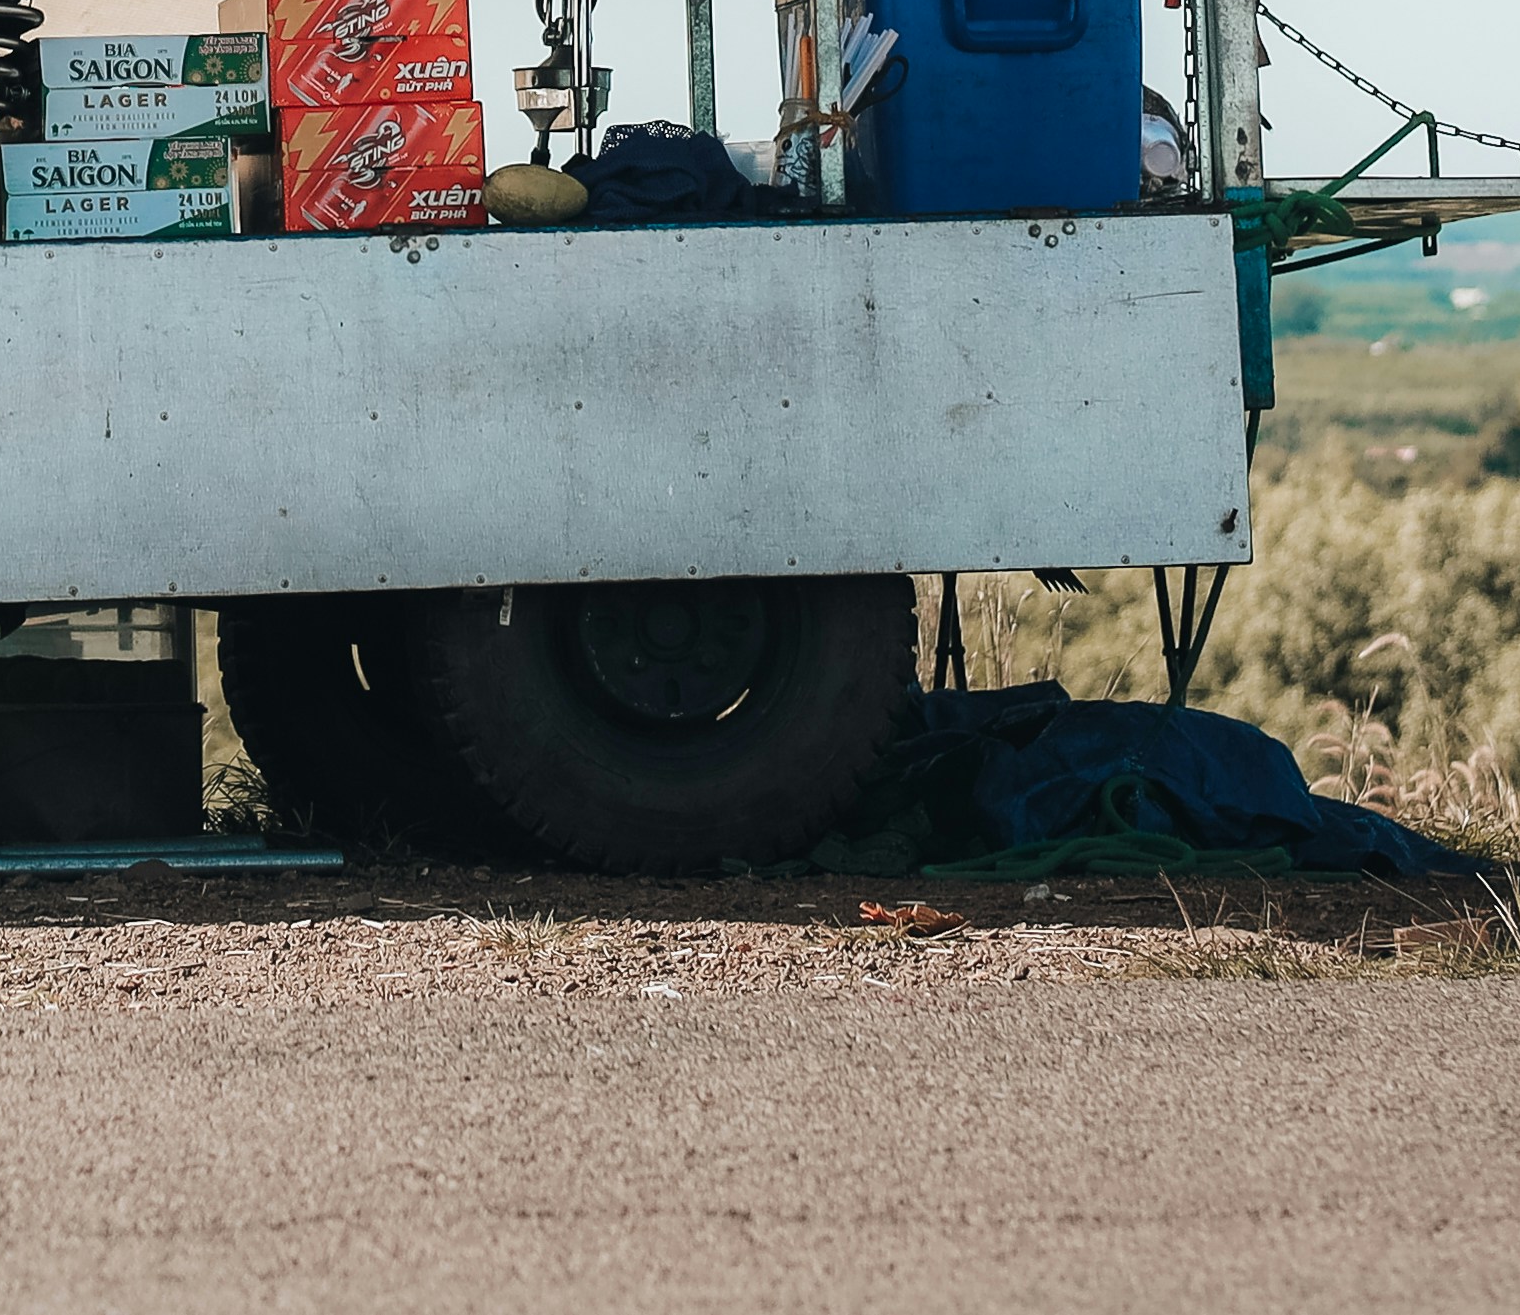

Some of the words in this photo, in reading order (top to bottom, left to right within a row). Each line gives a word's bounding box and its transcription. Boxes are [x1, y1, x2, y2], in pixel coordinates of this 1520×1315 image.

[334, 3, 390, 39] STING
[104, 42, 136, 58] BIA
[69, 58, 174, 83] SAIGON
[393, 55, 468, 80] xuân
[83, 92, 168, 110] LAGER
[214, 90, 229, 104] 24
[234, 89, 259, 103] LON
[67, 149, 100, 164] BIA
[349, 133, 405, 170] STING
[31, 164, 137, 189] SAIGON
[45, 196, 130, 214] LAGER
[178, 193, 193, 207] 24
[197, 192, 223, 206] LON
[408, 183, 483, 207] xuân
